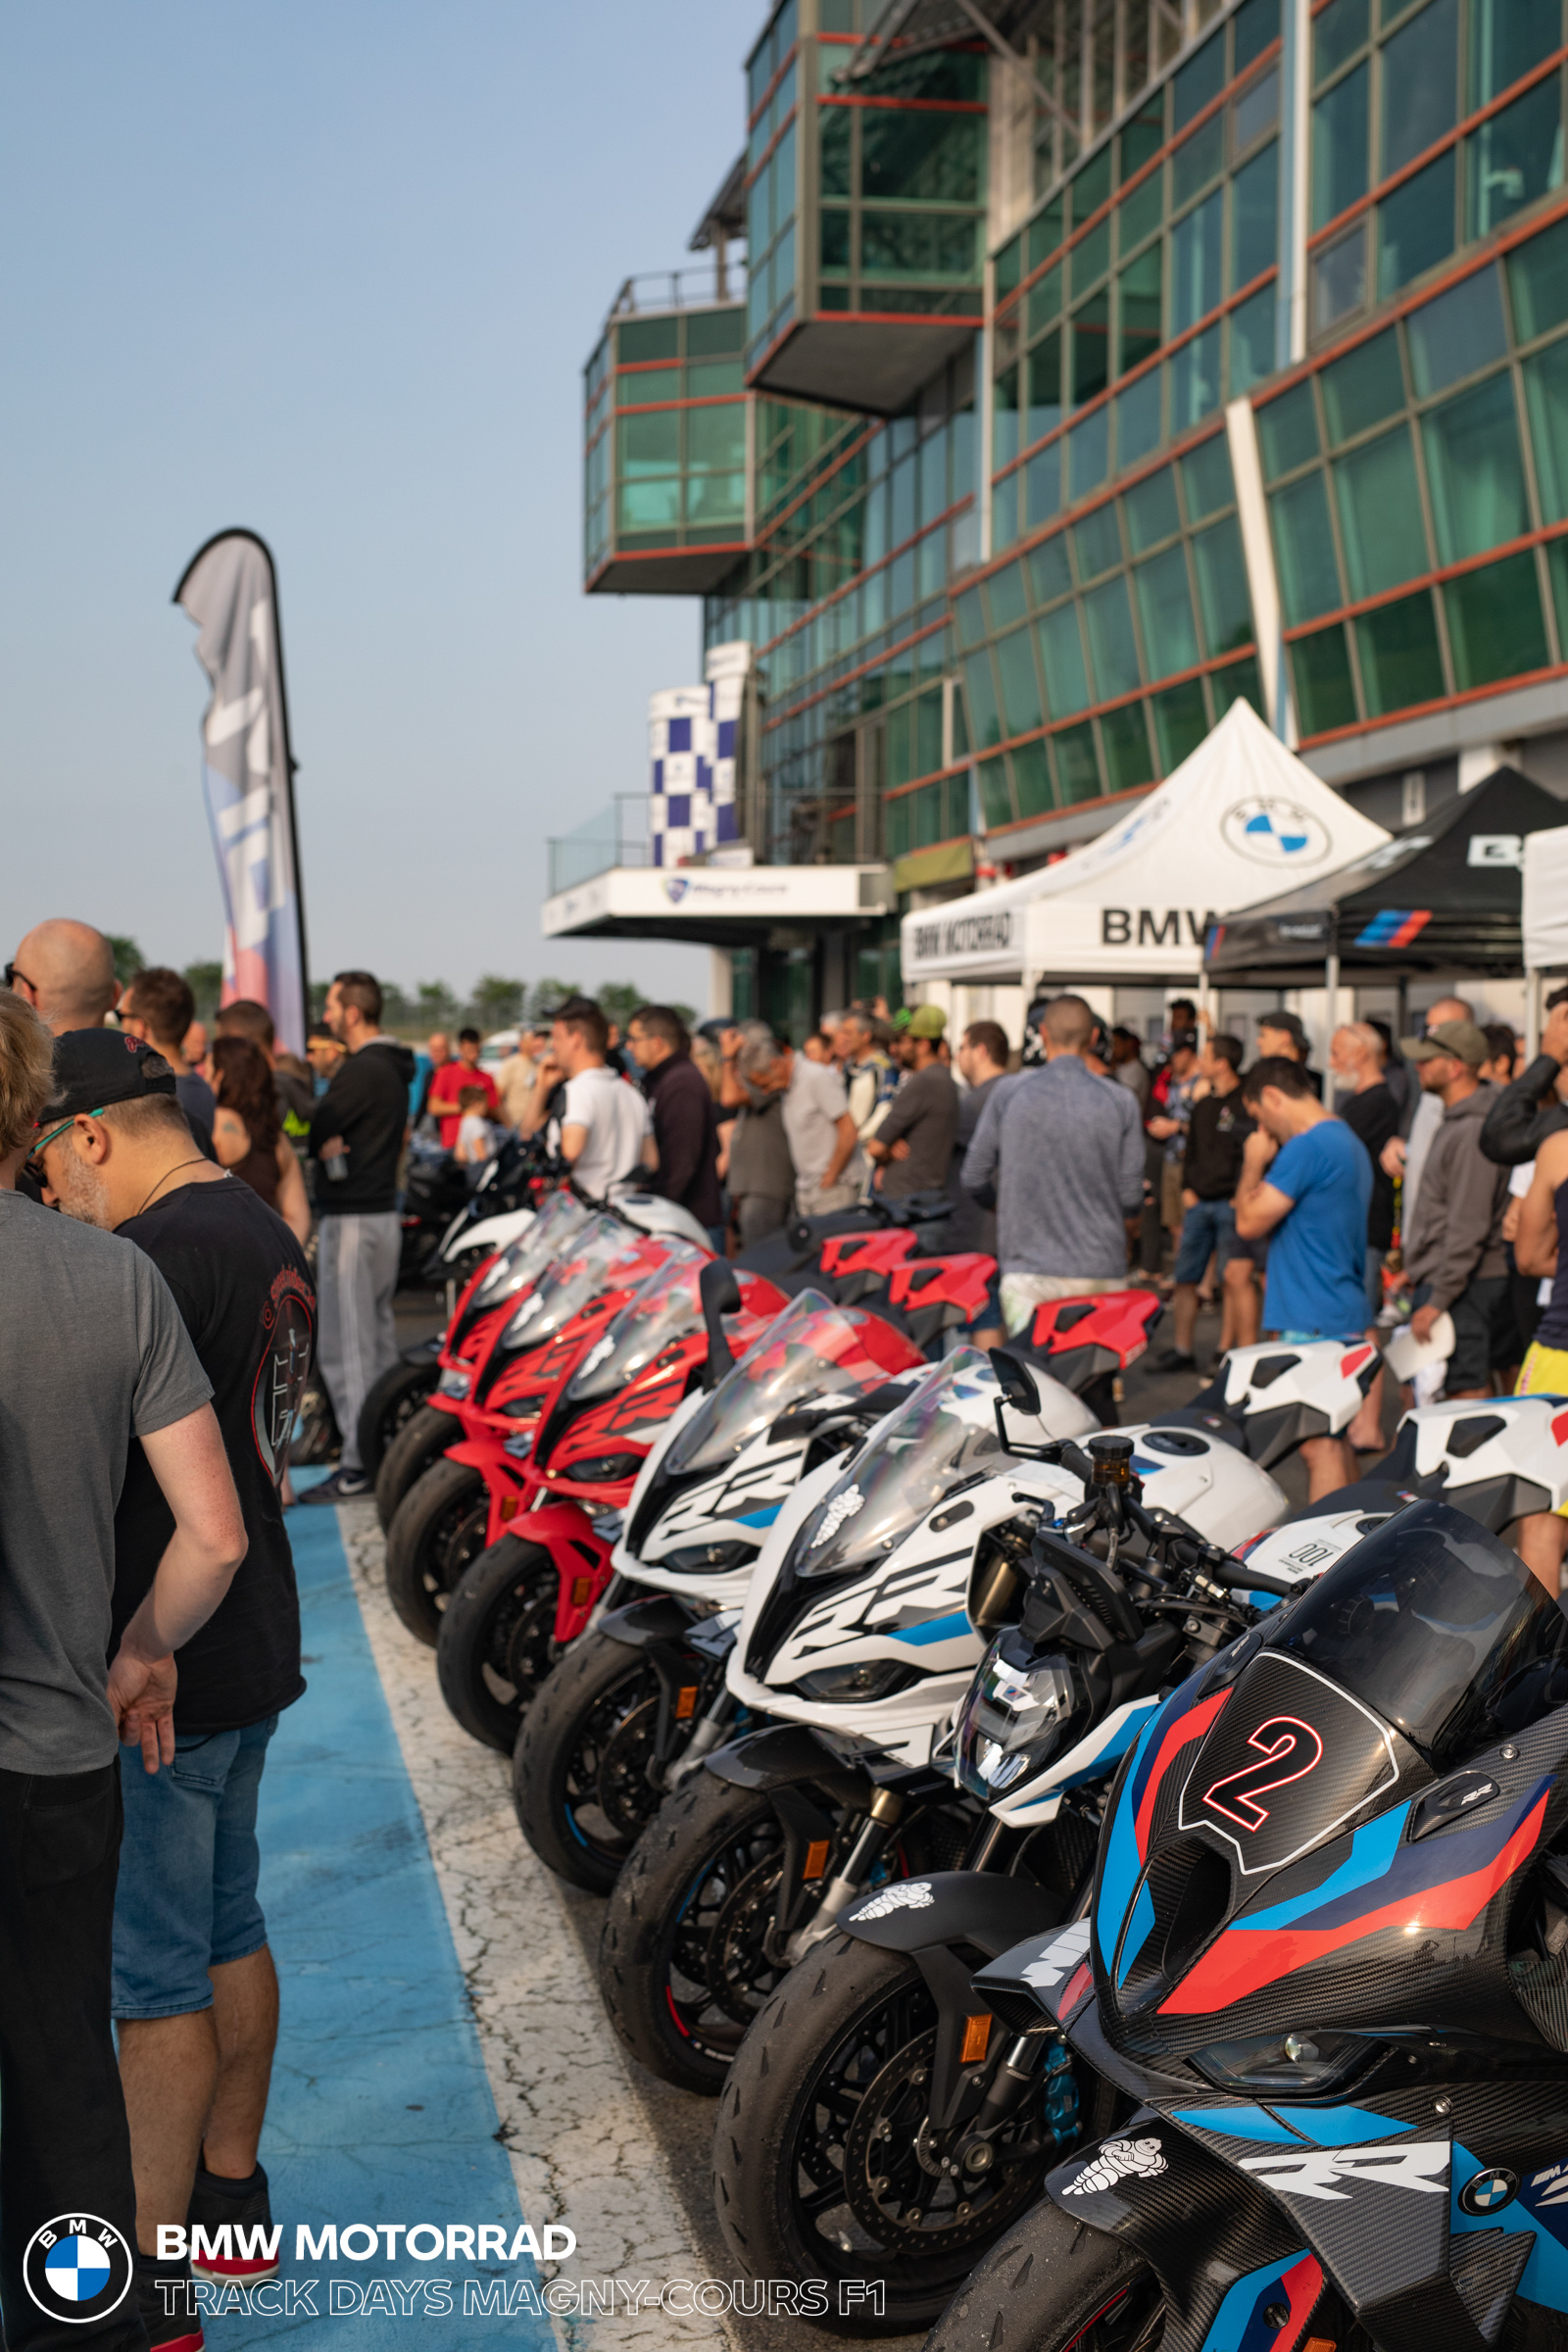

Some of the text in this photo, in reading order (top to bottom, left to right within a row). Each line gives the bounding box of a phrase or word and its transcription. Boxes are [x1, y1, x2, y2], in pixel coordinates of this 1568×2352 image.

[1201, 1715, 1324, 1834] 2
[1237, 2140, 1451, 2201] RR
[1471, 2170, 1515, 2189] BMW
